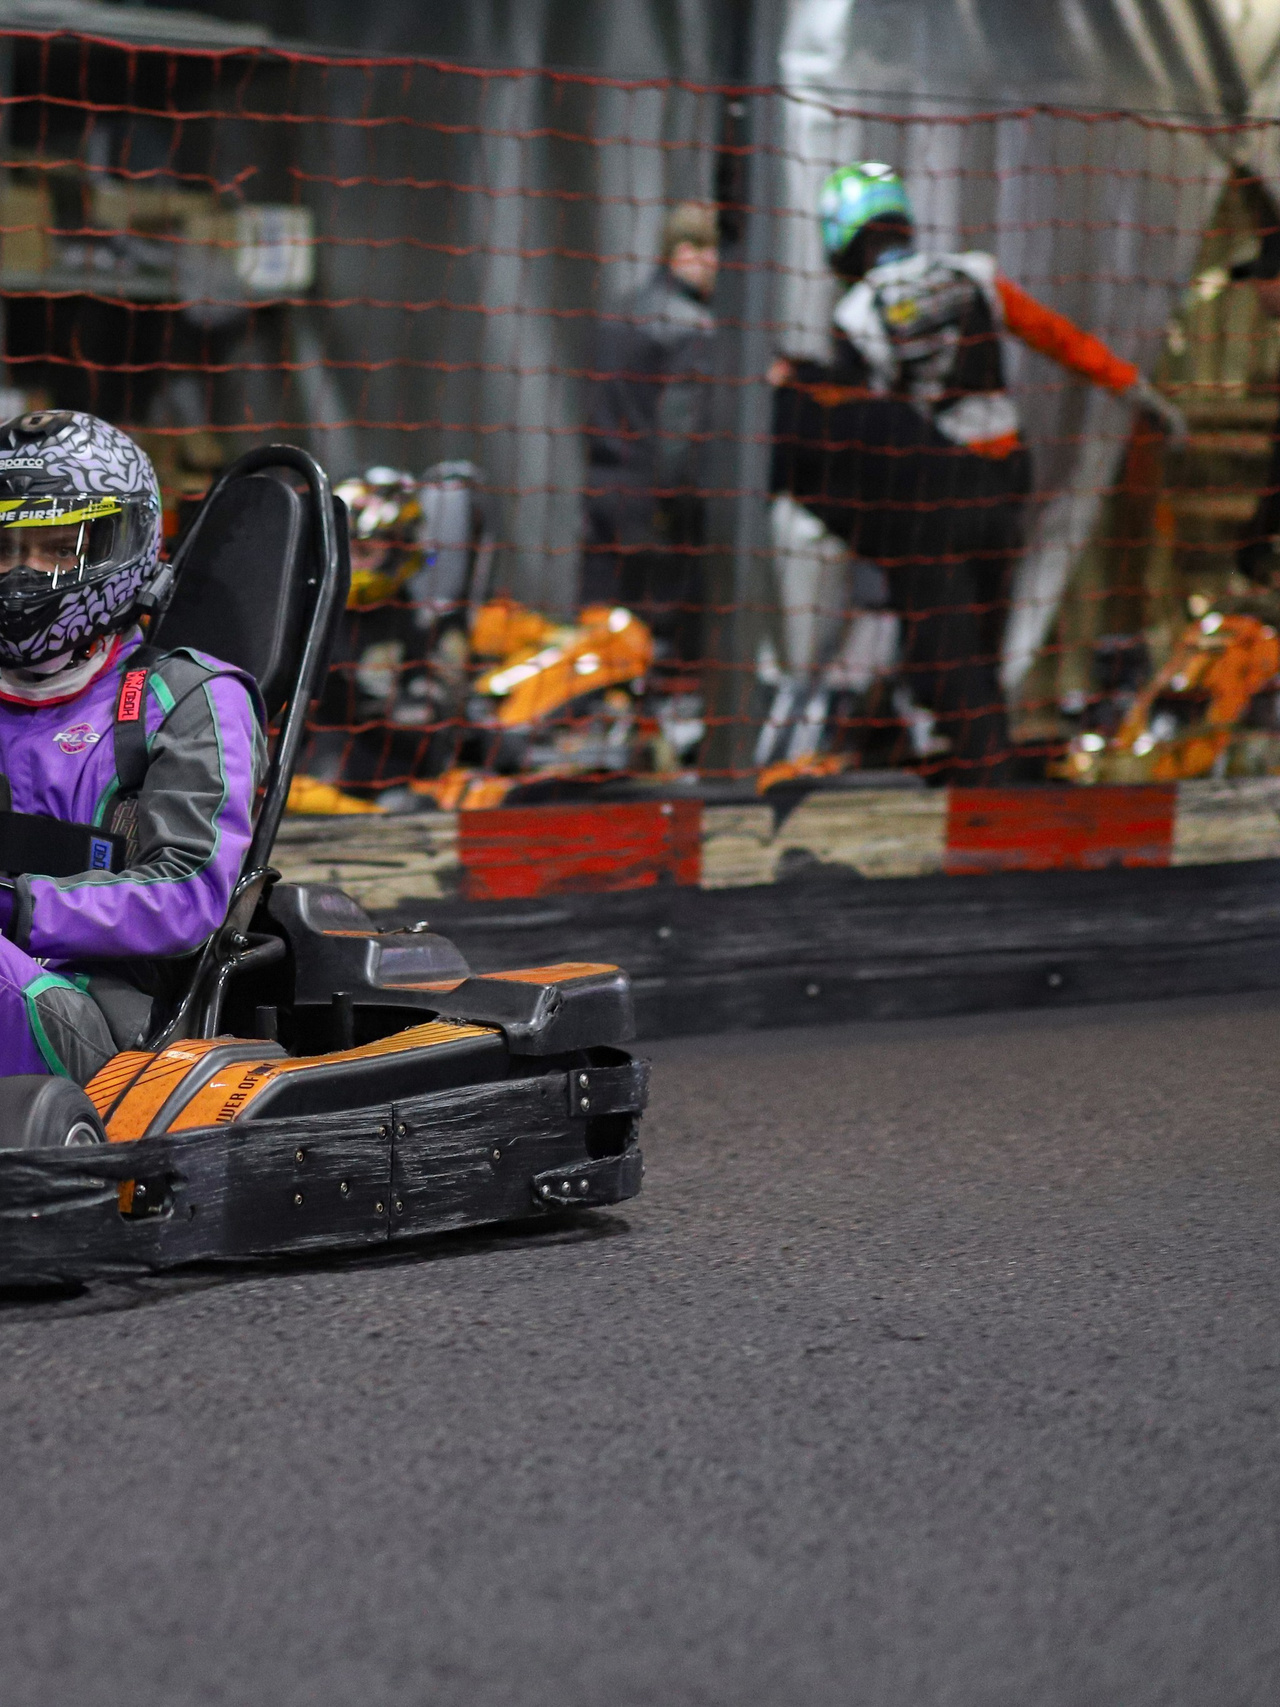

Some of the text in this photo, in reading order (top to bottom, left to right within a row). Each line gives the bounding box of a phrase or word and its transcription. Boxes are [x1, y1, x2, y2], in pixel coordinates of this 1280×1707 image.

[18, 508, 65, 521] FIRST
[52, 732, 100, 743] RLG
[93, 843, 107, 870] OGO
[215, 1093, 247, 1122] WER
